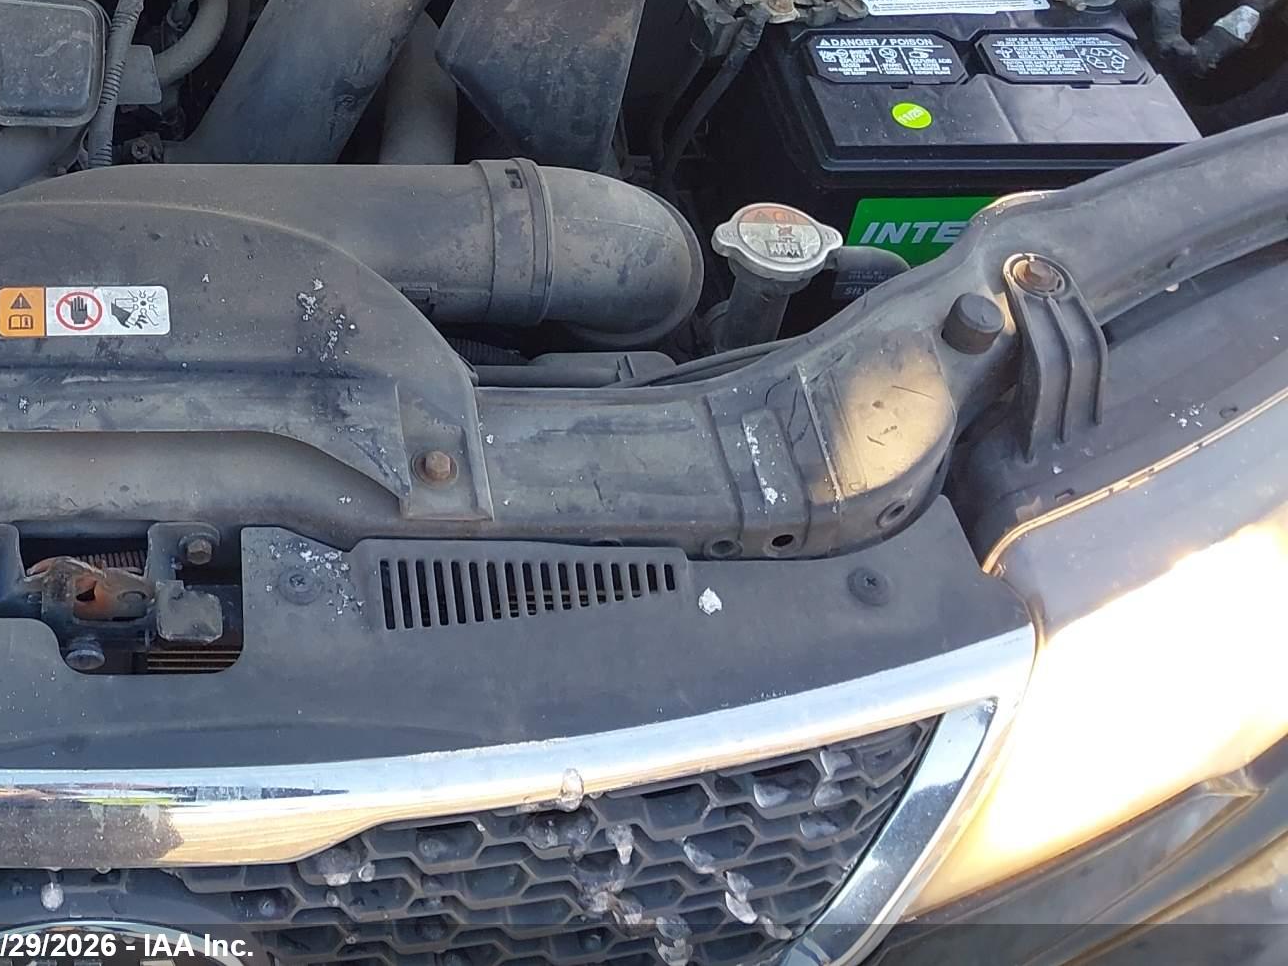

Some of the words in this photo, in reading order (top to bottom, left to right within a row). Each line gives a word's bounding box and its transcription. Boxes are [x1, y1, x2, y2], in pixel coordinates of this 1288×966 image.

[830, 38, 879, 47] DANGER
[890, 38, 934, 47] POISON
[859, 221, 968, 244] INTE
